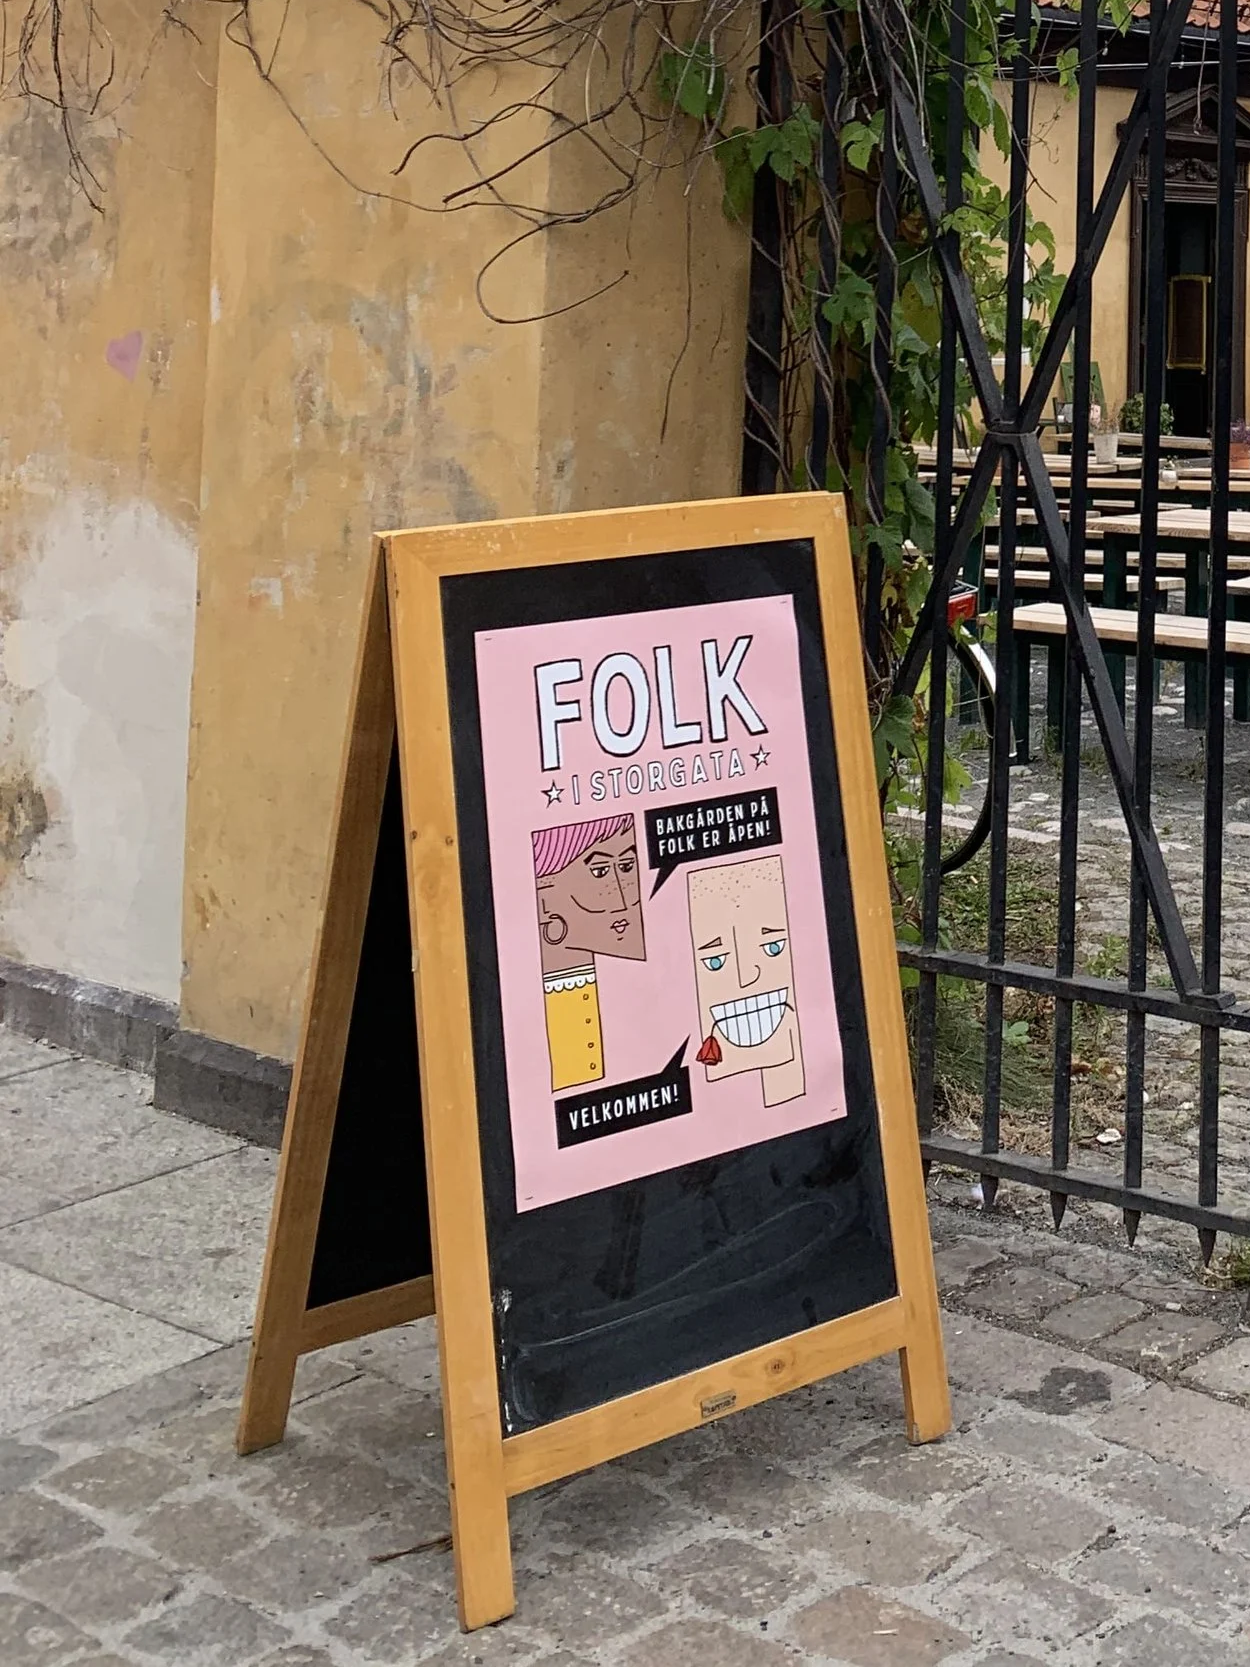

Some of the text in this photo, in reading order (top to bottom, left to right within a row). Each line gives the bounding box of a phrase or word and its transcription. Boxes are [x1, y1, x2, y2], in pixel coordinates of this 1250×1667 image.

[534, 635, 769, 772] FOLK
[572, 748, 745, 806] I STORGATA
[656, 796, 769, 835] BAKGÅRDEN PÅ
[659, 820, 771, 857] FOLK ER ÅPEN!
[569, 1083, 679, 1130] VELKOMMEN!
